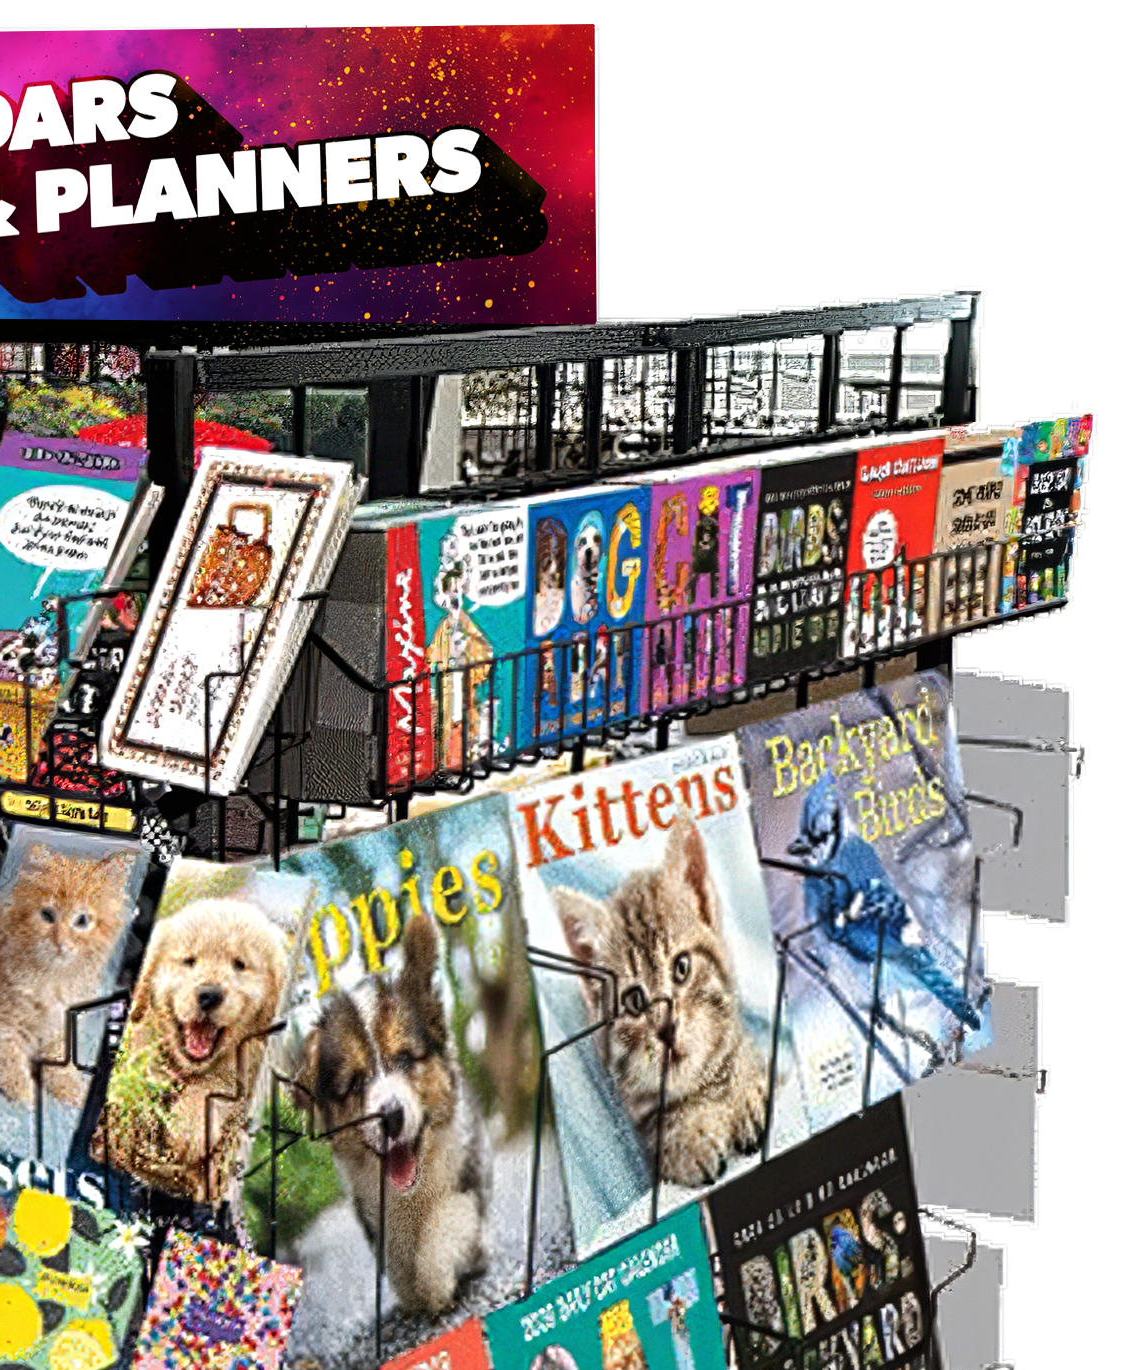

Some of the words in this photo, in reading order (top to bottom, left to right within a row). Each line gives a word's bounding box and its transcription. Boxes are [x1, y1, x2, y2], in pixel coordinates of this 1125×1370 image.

[35, 128, 482, 233] PLANNERS
[534, 501, 643, 638] DOG
[516, 764, 739, 869] Kittens
[309, 847, 503, 998] ppies
